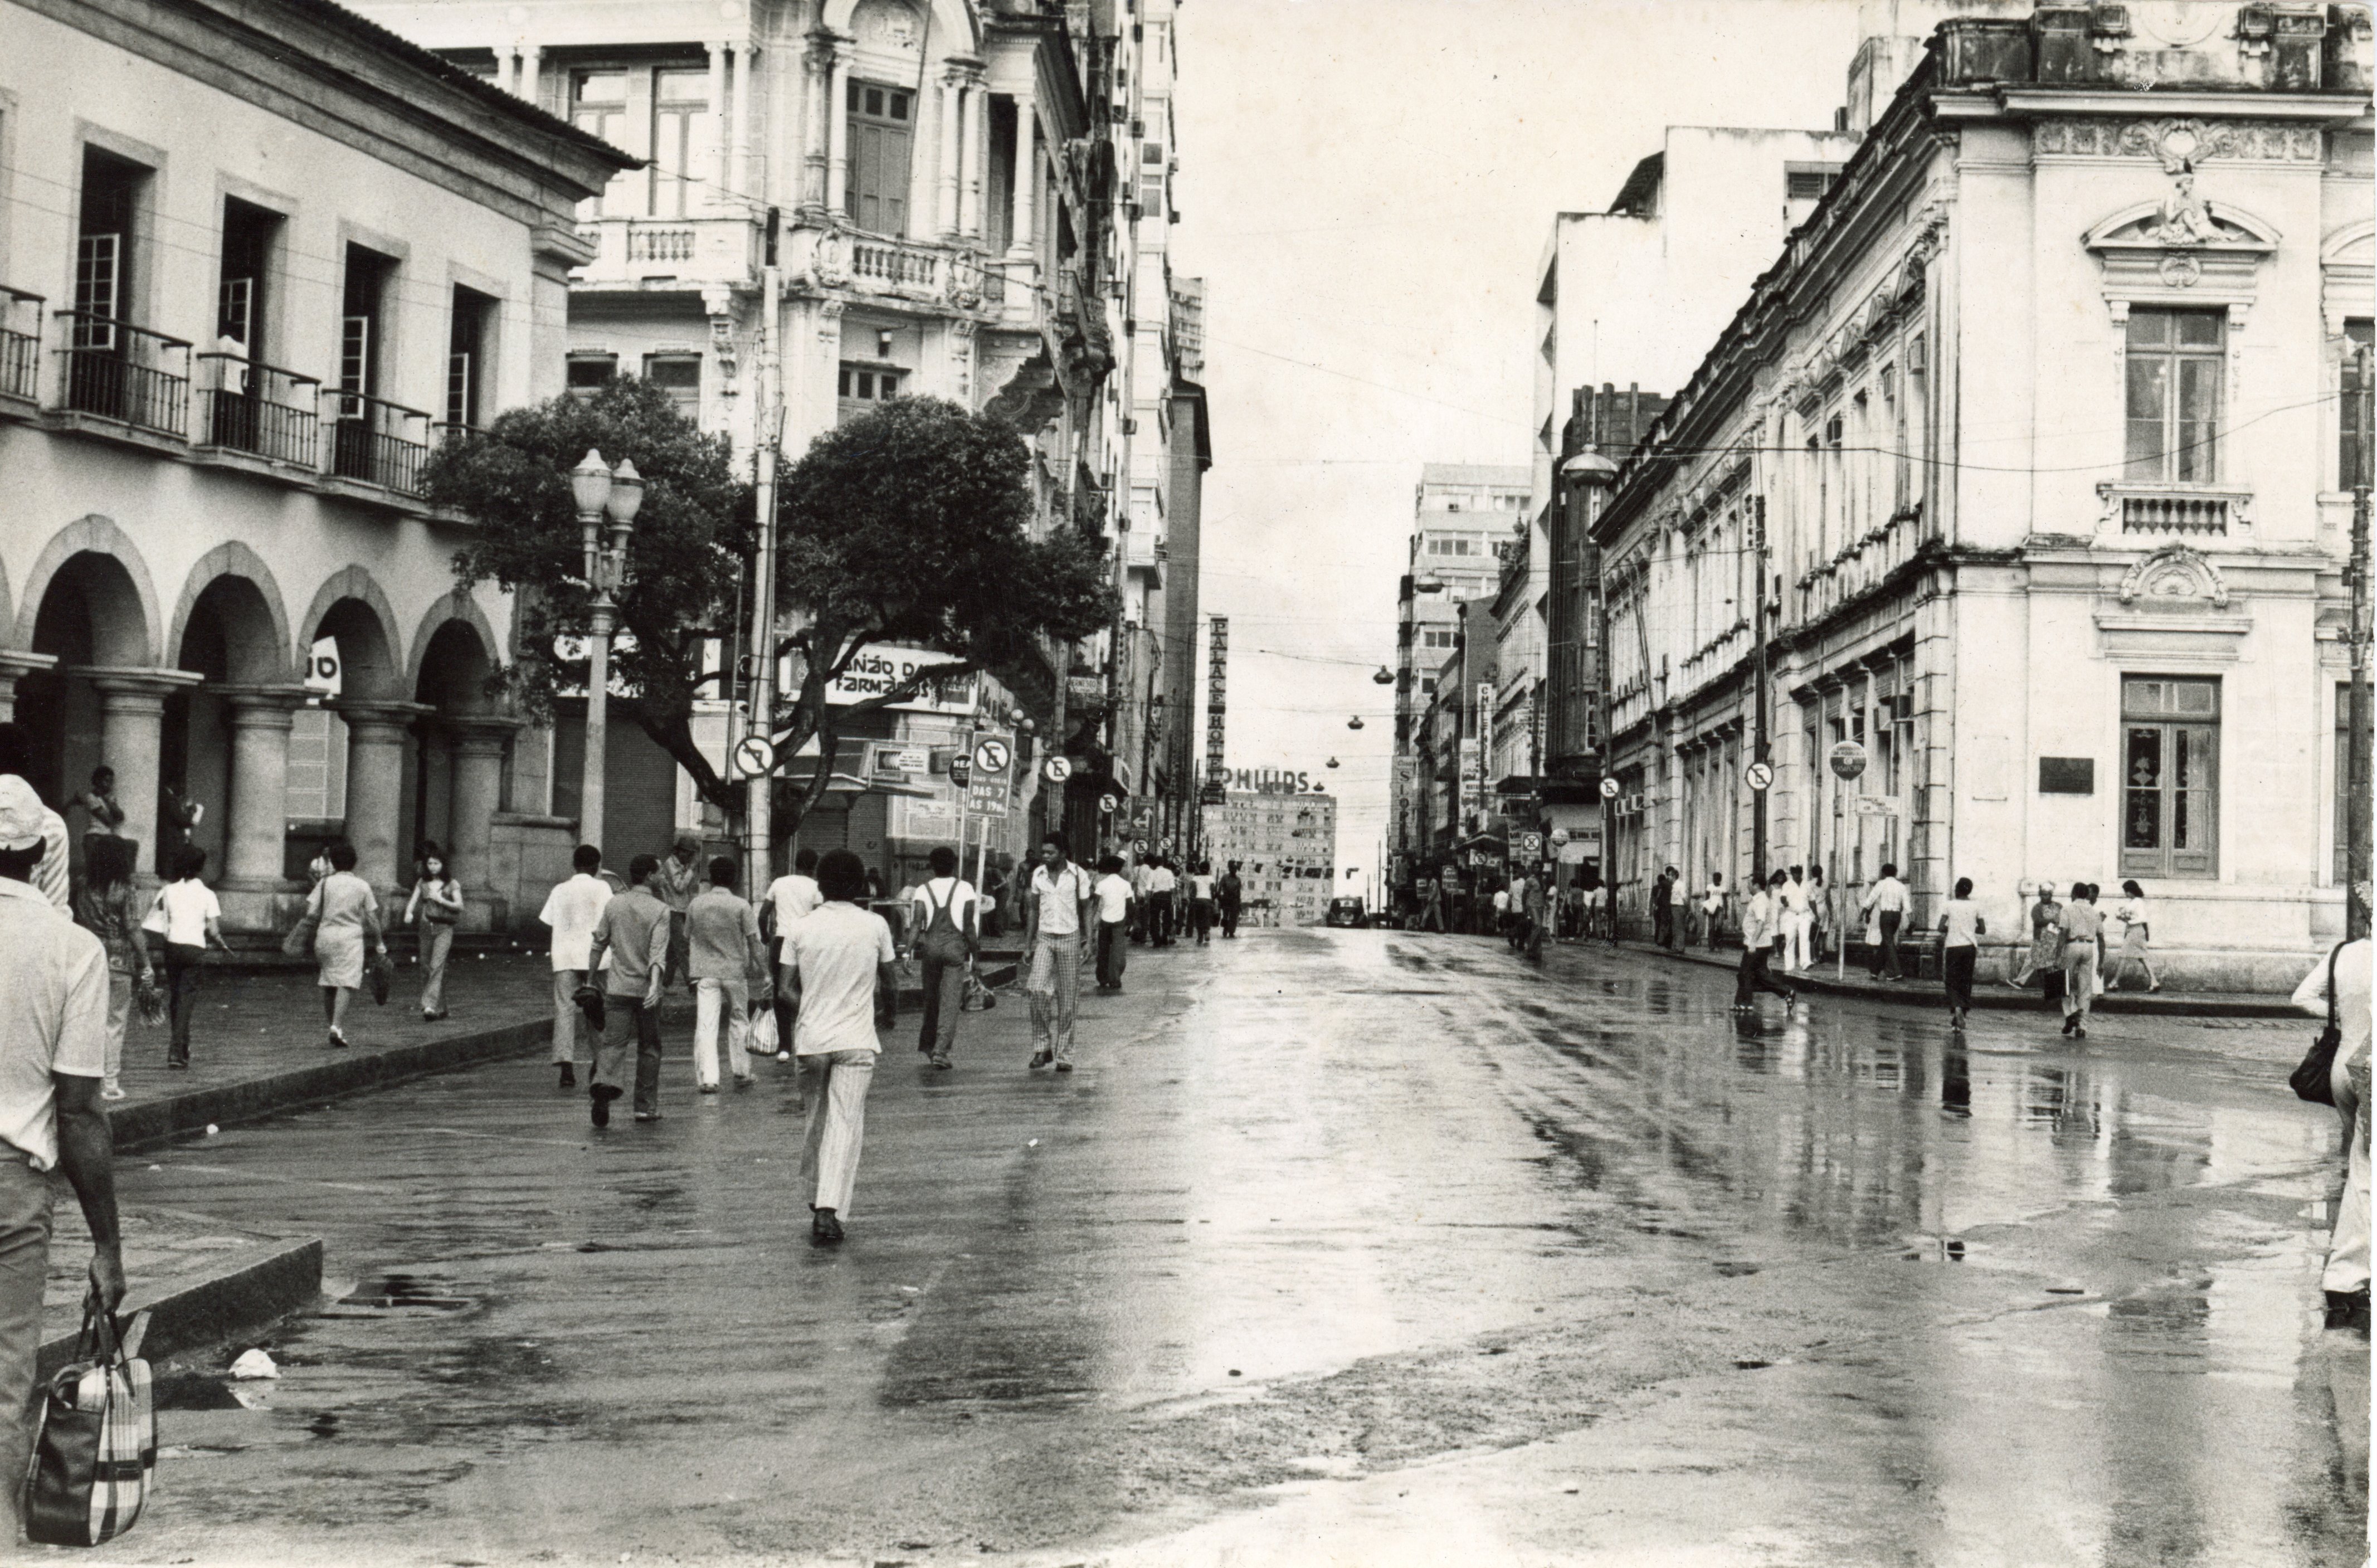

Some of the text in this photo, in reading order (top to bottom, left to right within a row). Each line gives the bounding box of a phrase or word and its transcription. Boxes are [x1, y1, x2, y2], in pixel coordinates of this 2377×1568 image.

[1209, 622, 1225, 783] PALACE HOTEL
[953, 760, 971, 768] REA
[1221, 767, 1309, 794] PHILIPS
[972, 785, 1005, 798] DAS 7
